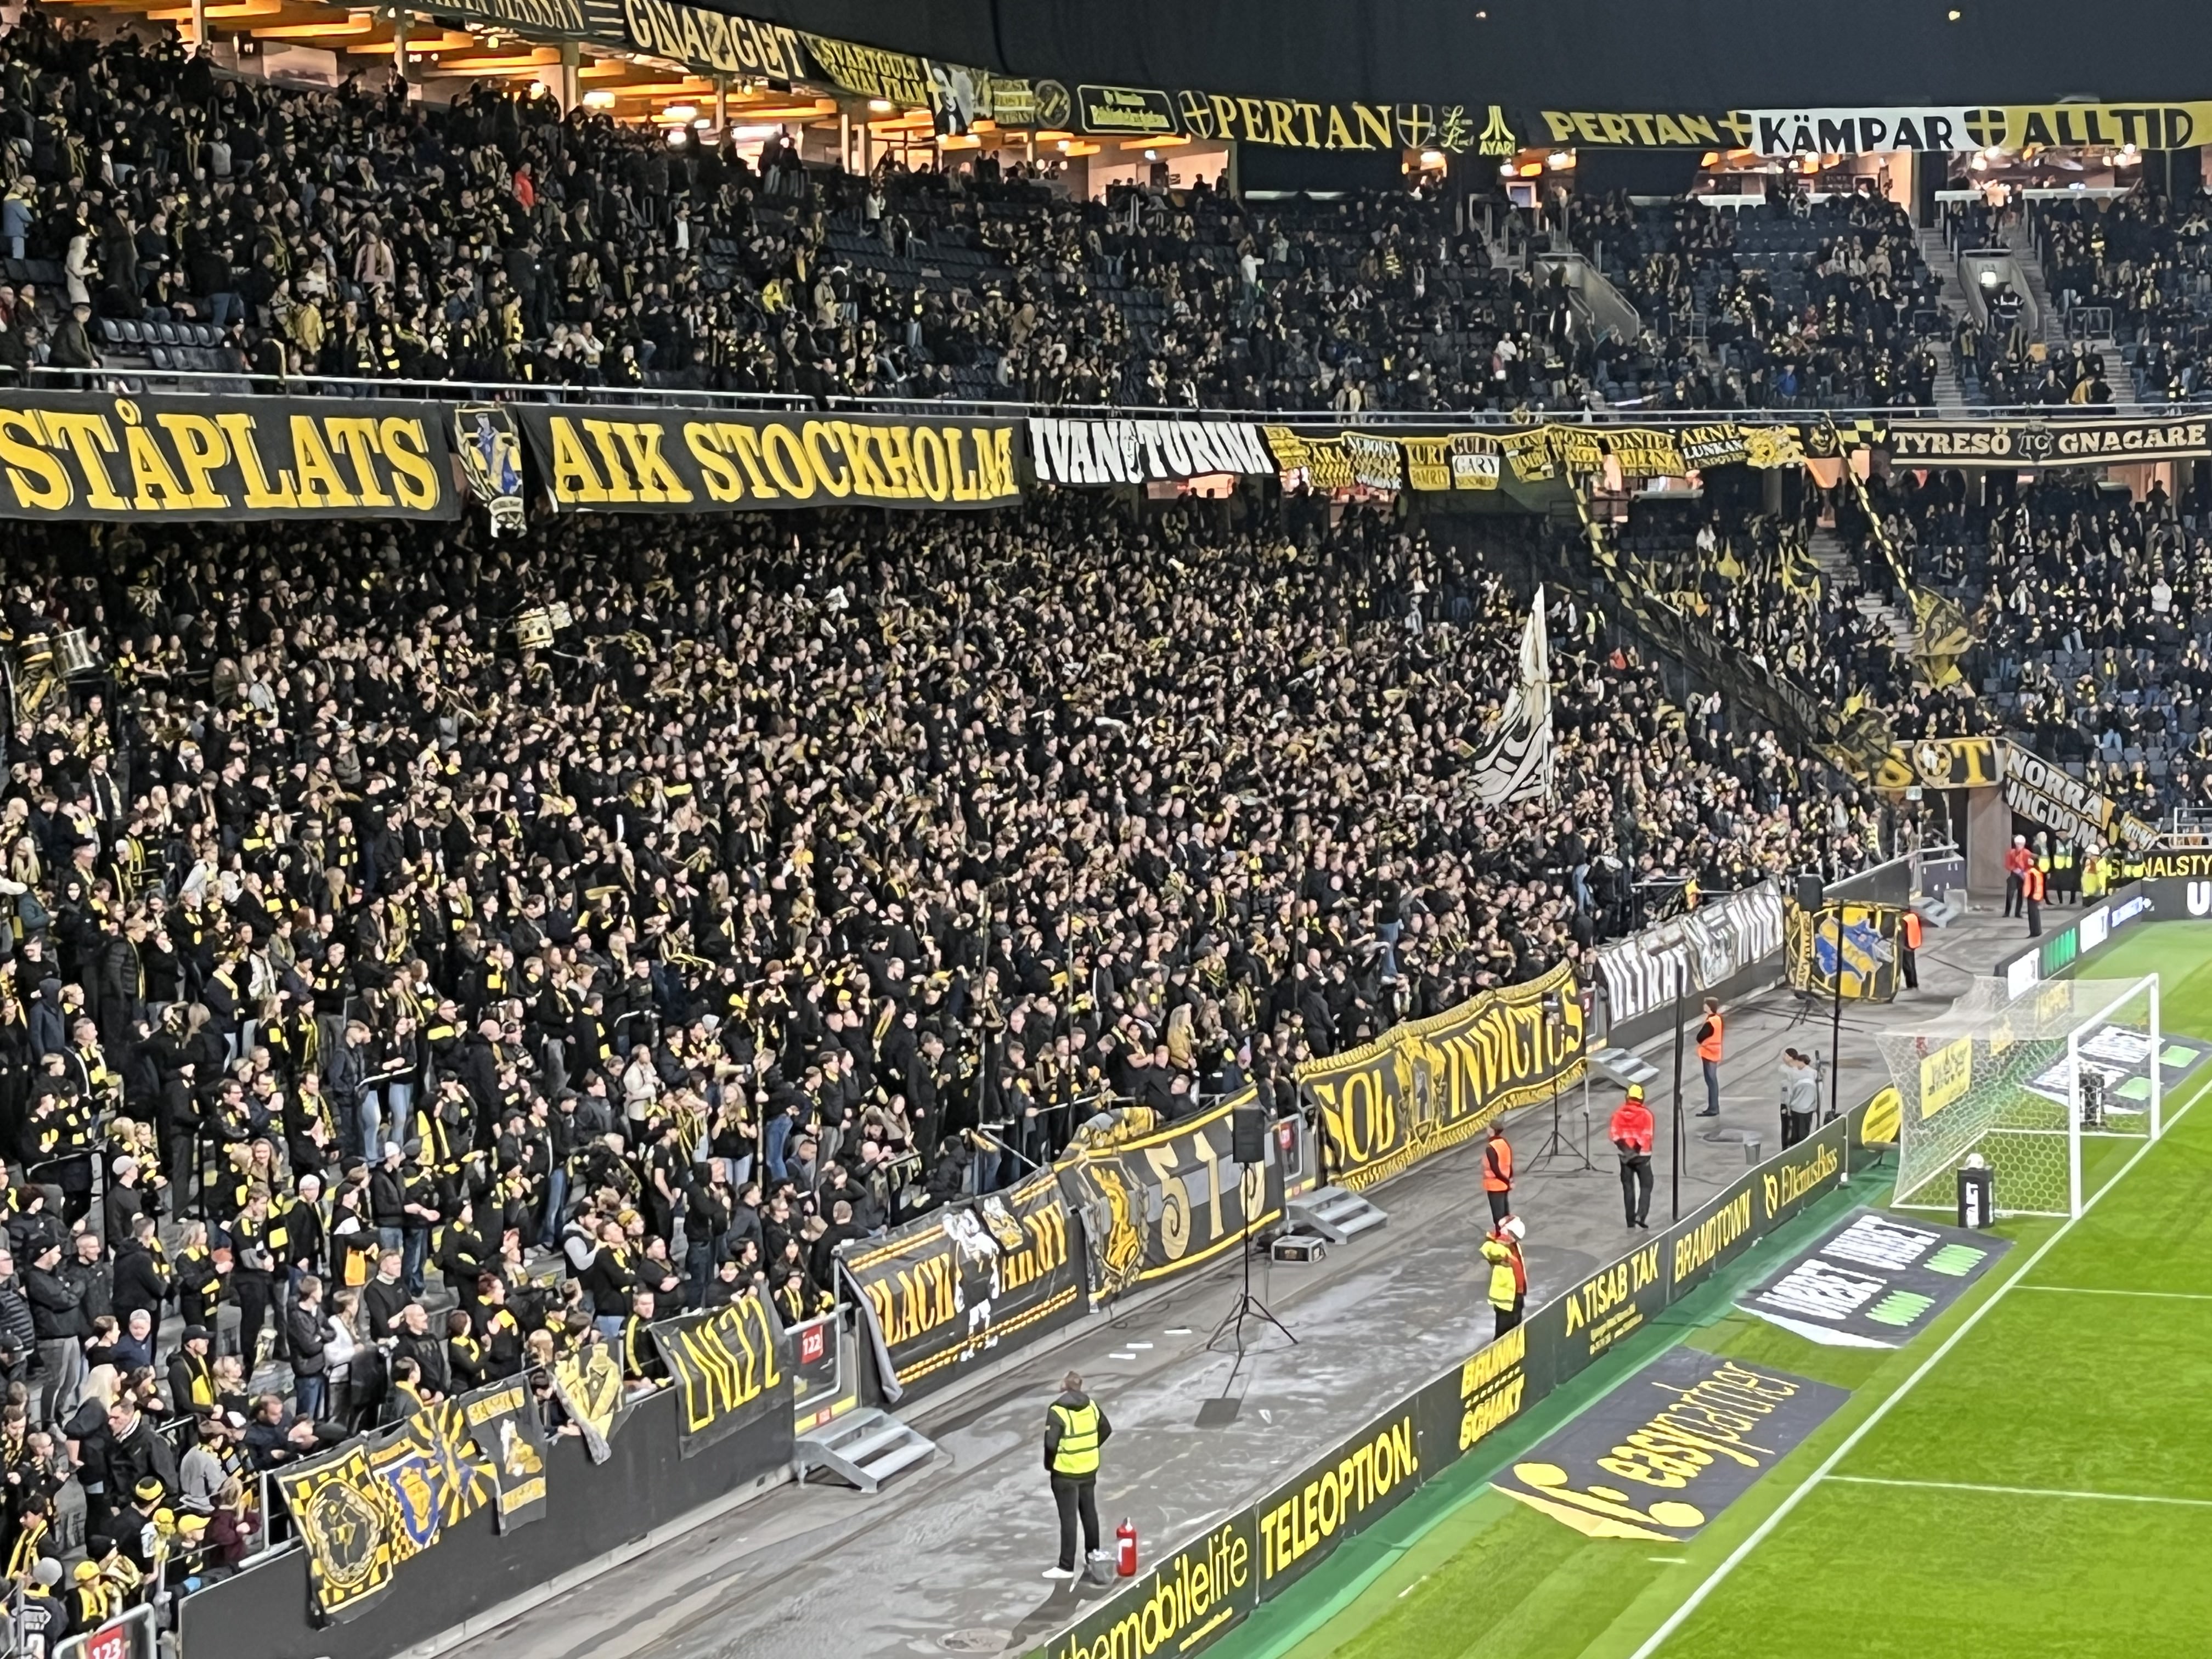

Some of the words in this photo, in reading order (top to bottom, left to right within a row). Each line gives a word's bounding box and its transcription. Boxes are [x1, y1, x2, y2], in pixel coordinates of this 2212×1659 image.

[1209, 94, 1392, 150] PERTAN
[1541, 111, 1720, 145] PERTAN
[1759, 114, 1954, 155] KÄMPAR
[2023, 108, 2193, 149] ALLTID
[0, 399, 440, 511] STÅPLATS
[549, 416, 695, 504] AIK
[683, 420, 1020, 503] STOCKHOLM
[1029, 418, 1126, 483] IVAN
[1136, 420, 1274, 478] TURINA
[1452, 437, 1499, 455] GULD
[1681, 424, 1738, 447] ARNE
[1892, 427, 2012, 455] TYRESÖ
[2058, 425, 2207, 455] GNAGARE
[1455, 458, 1497, 474] GARY
[2007, 748, 2102, 823] NORRA
[1313, 1069, 1395, 1167] SOL
[1442, 976, 1583, 1119] INVICTUS
[1675, 1188, 1752, 1284] BRANDTOWN
[1583, 1263, 1628, 1323] TISAB
[1630, 1241, 1659, 1293] TAK
[802, 1334, 822, 1356] 122
[1596, 1361, 1800, 1488] easypartner
[1261, 1415, 1418, 1579] TELEOPTION.
[92, 1638, 121, 1659] 123
